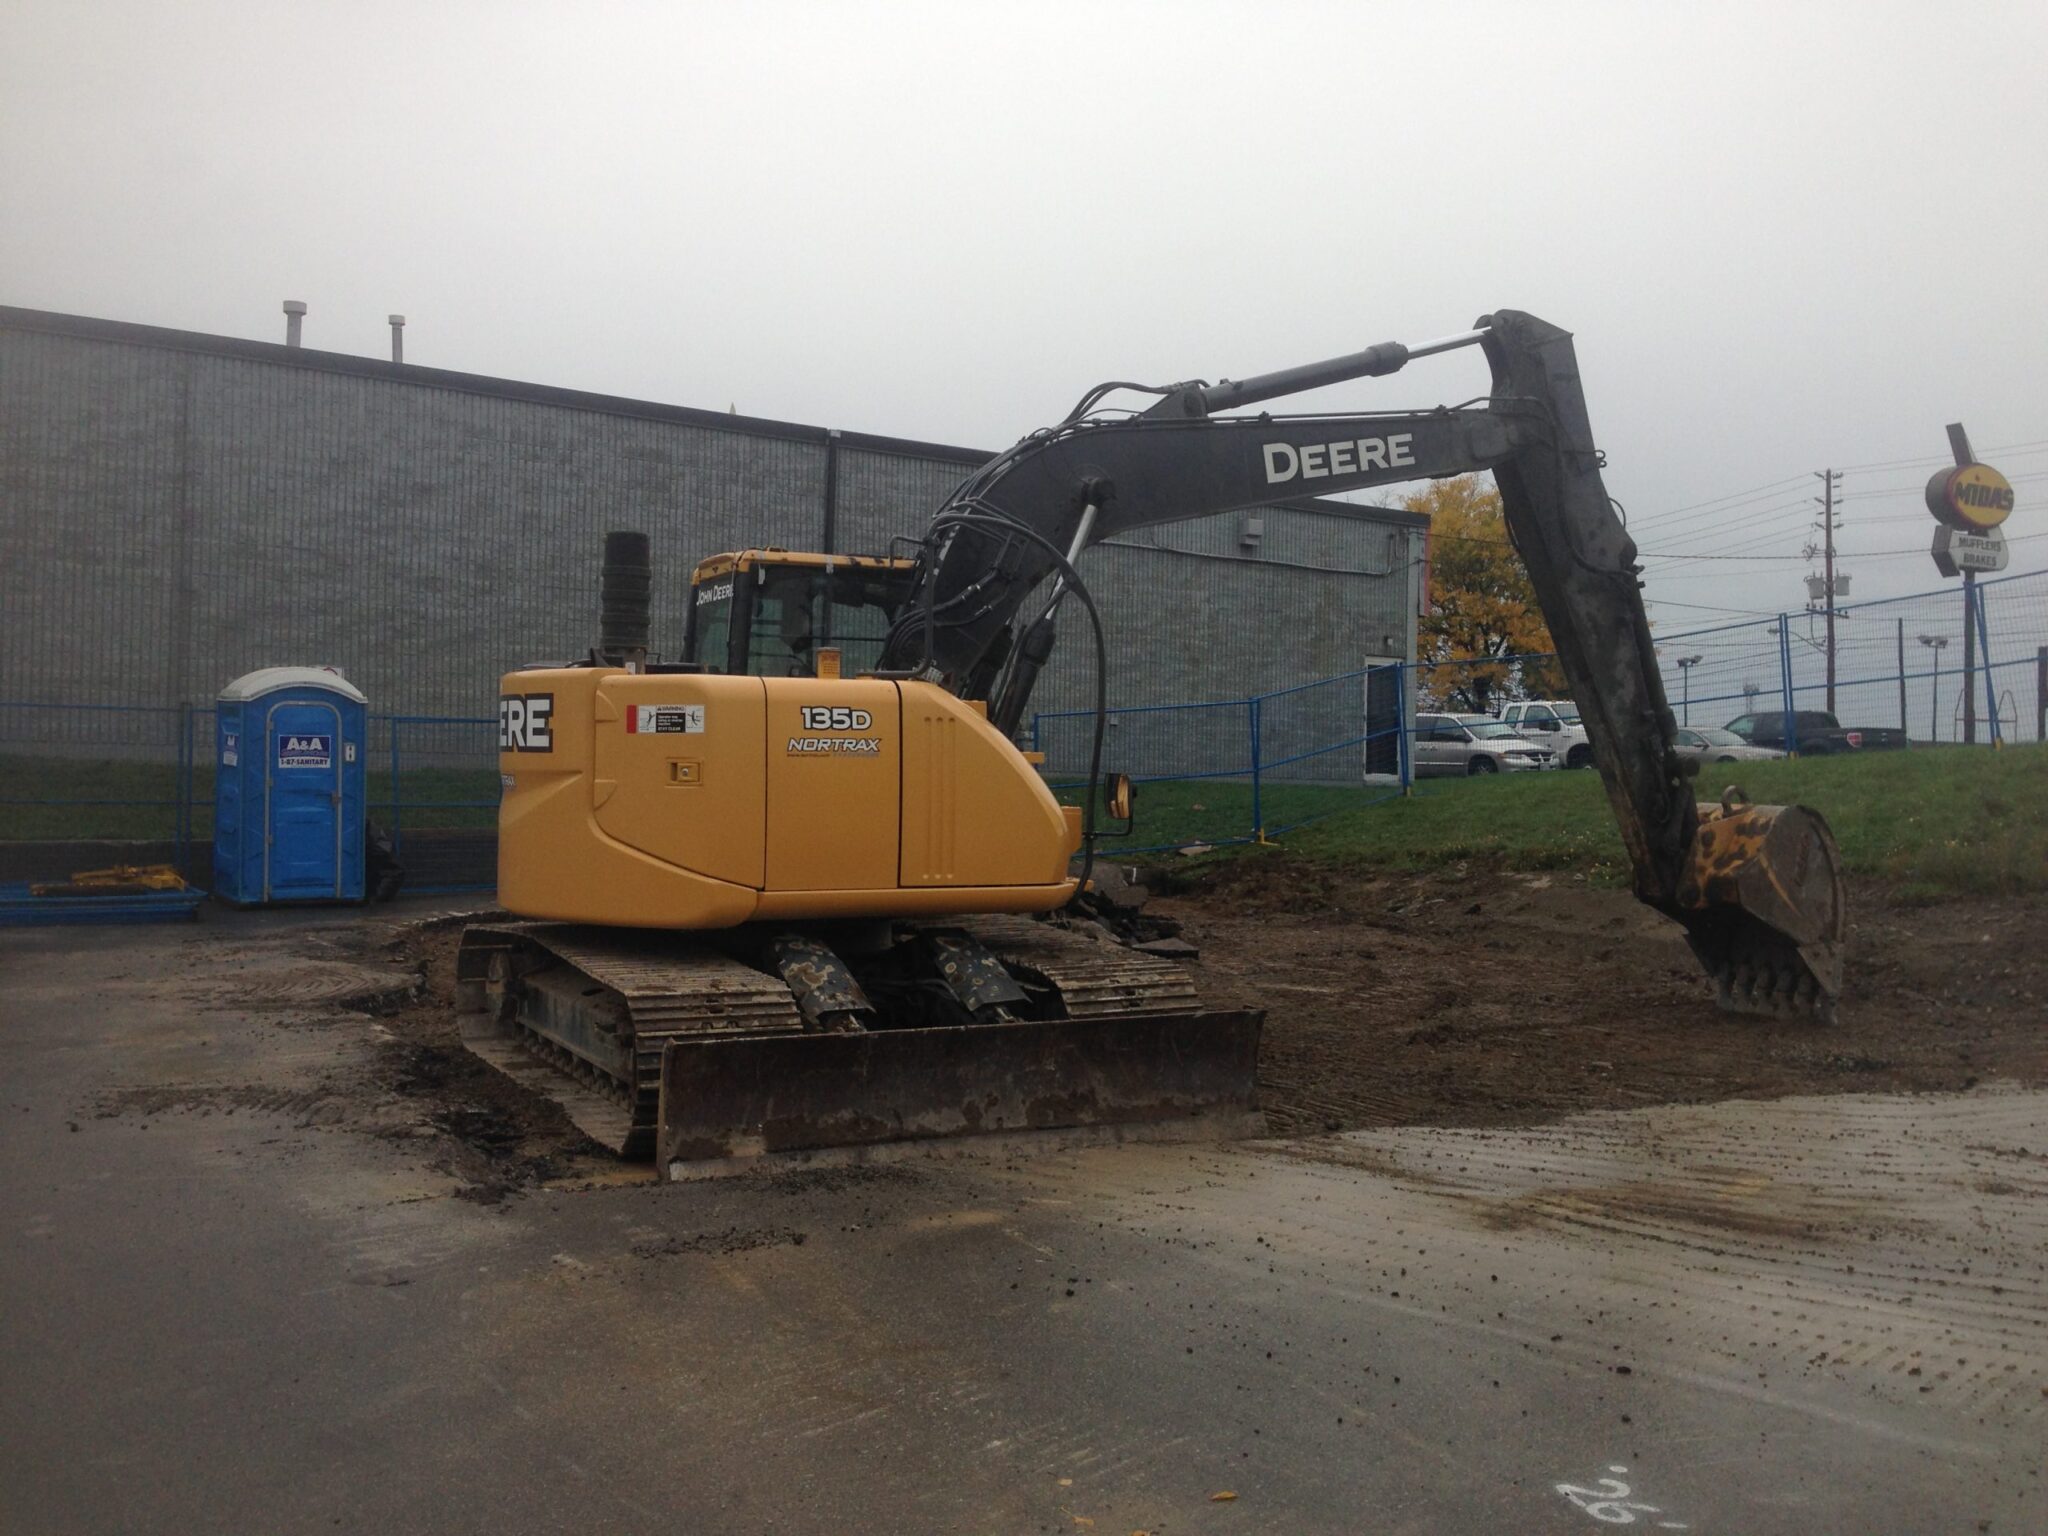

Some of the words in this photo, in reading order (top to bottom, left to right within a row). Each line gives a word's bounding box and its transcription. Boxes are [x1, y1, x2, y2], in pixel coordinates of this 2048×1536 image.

[1263, 433, 1416, 484] DEERE
[1955, 482, 2014, 511] MIDAS
[1963, 553, 1997, 567] BRAKES
[696, 589, 713, 606] JOHN
[801, 706, 872, 730] 135D
[286, 737, 323, 751] A&A
[788, 738, 881, 752] NORTRAX
